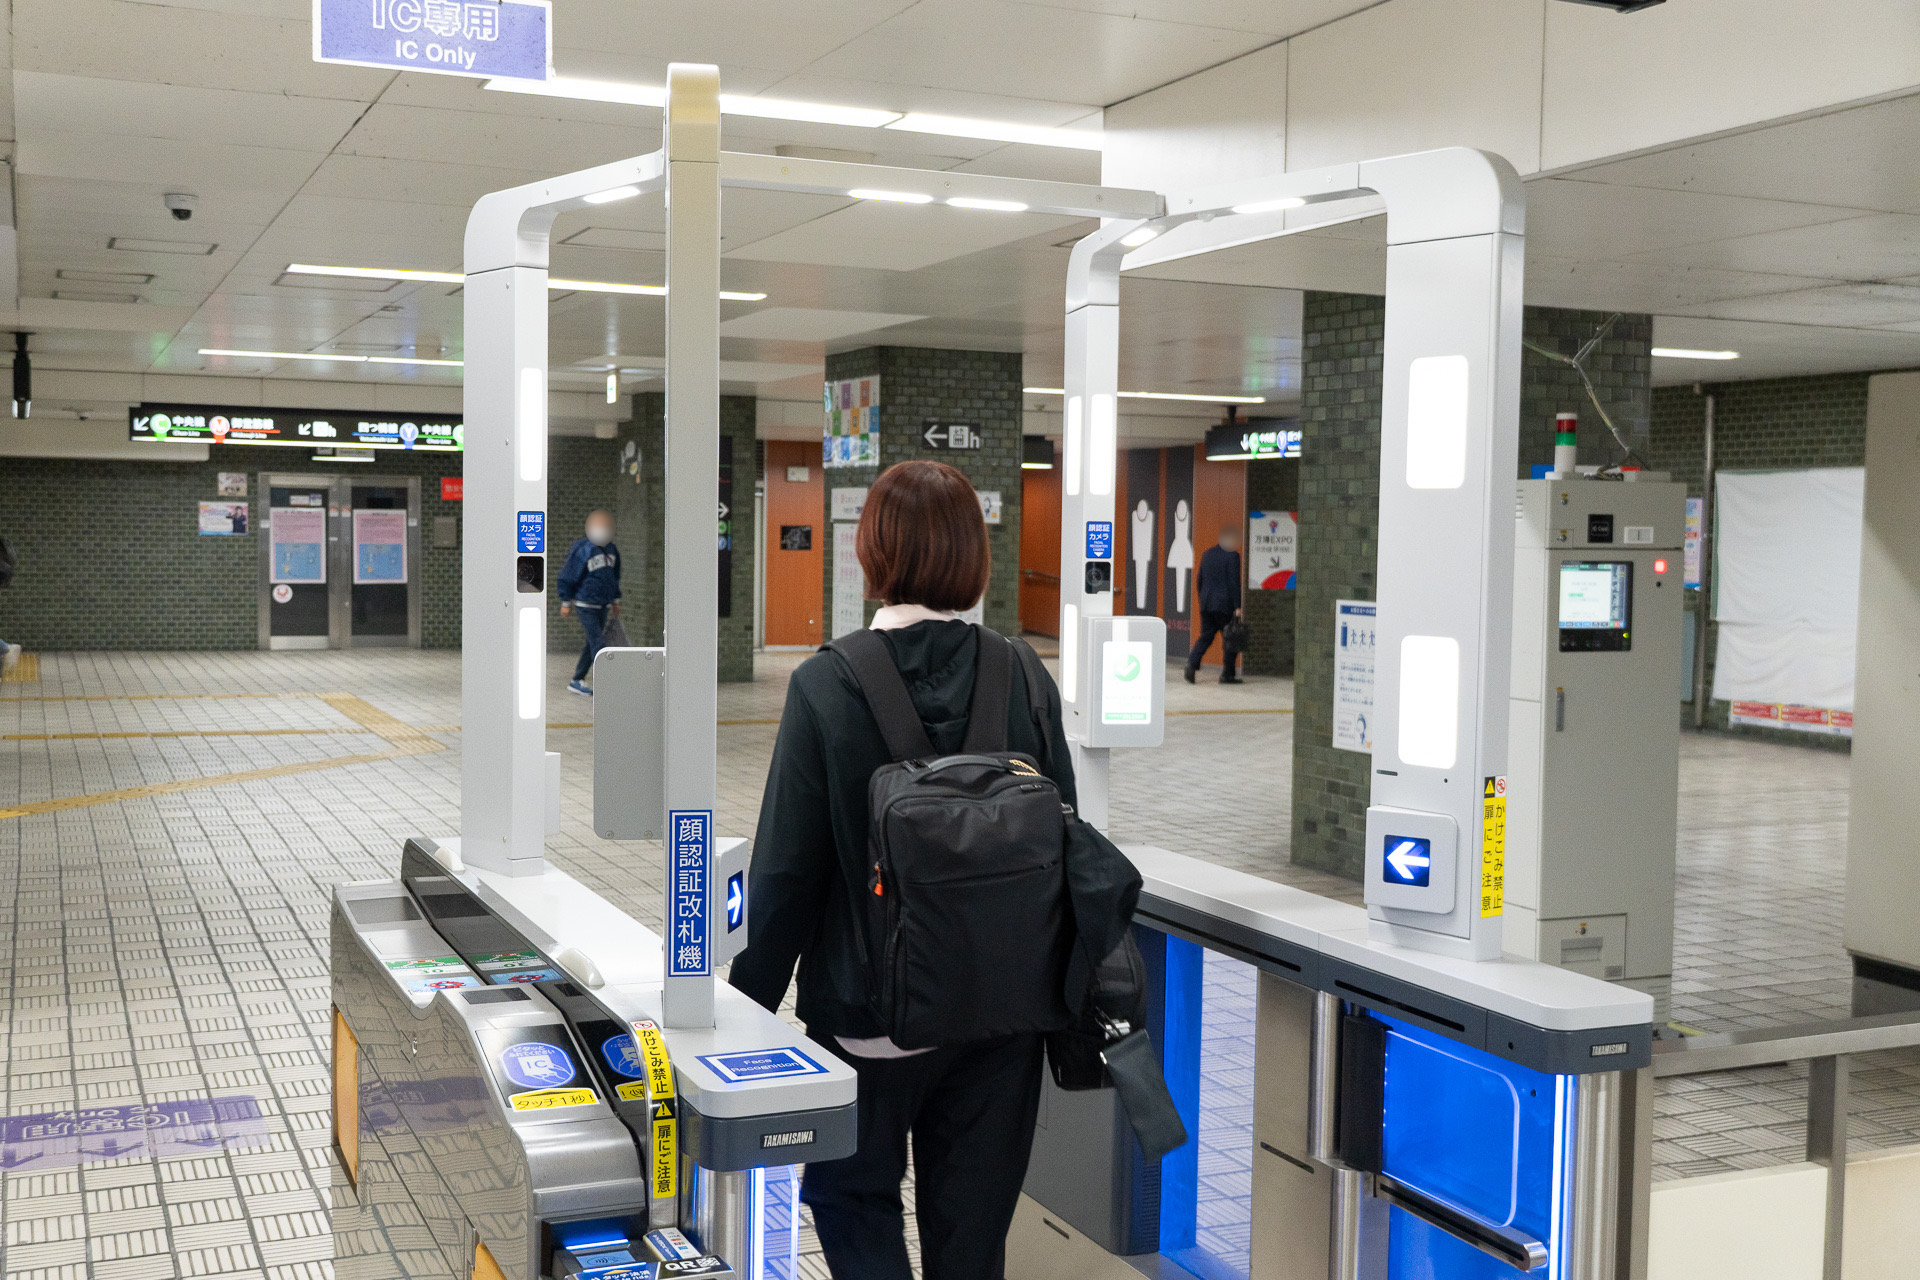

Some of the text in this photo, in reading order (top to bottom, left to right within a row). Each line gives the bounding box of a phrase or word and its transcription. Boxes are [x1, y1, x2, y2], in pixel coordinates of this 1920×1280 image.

[395, 40, 476, 70] IC Only
[520, 514, 543, 523] 顔認証
[521, 524, 542, 533] カメラ
[1089, 524, 1110, 532] 顔認証
[1089, 533, 1109, 541] カメラ
[1481, 804, 1495, 911] 扉にご注意
[1493, 804, 1506, 910] かけこみ禁止
[677, 818, 704, 970] 顔認証改札機
[526, 1060, 548, 1069] IC
[641, 1030, 669, 1094] かけこみ禁止
[731, 1062, 799, 1073] Recognition
[763, 1130, 813, 1148] TAKAMISAWA
[657, 1124, 672, 1194] 扉にご注意
[665, 1261, 698, 1271] QR
